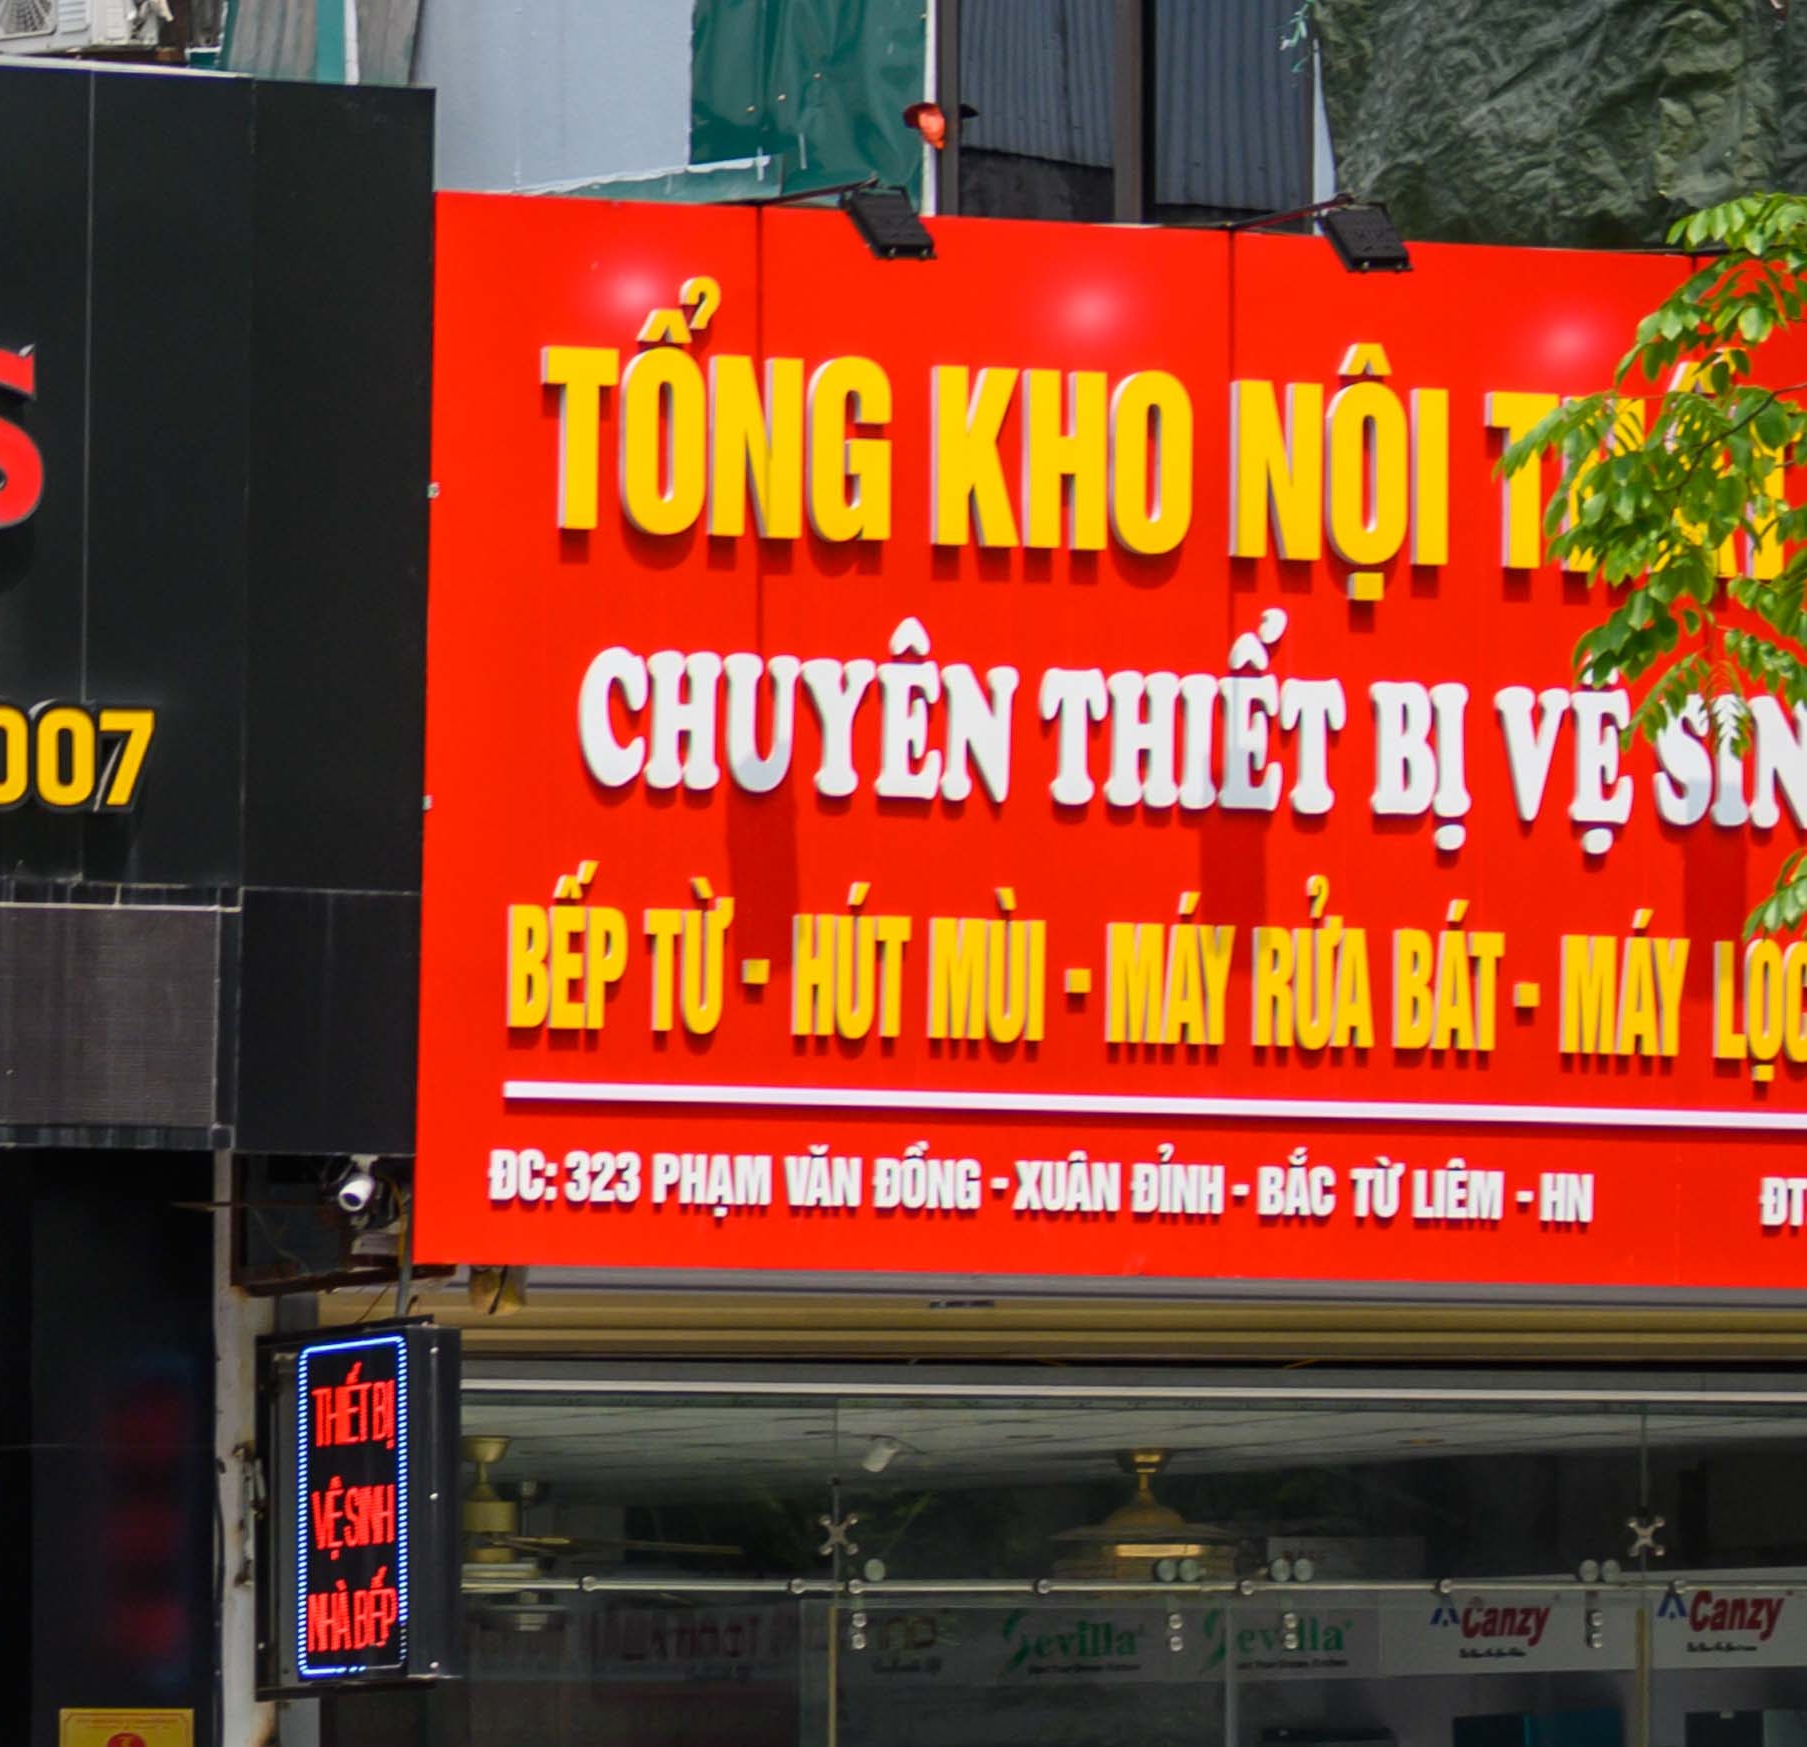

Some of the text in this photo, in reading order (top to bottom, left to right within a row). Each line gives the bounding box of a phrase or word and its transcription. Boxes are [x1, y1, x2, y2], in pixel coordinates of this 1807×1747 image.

[541, 276, 892, 543] TỔNG
[930, 364, 1193, 555] KHO
[1228, 343, 1450, 601] NỘI
[578, 616, 1020, 805] CHUYÊN
[1040, 607, 1346, 814] THIẾT
[1370, 681, 1471, 852] BỊ
[1494, 655, 1634, 855] VỆ
[506, 860, 627, 1031] BẾP
[643, 877, 735, 1035] TỪ
[791, 882, 912, 1040] HÚT
[926, 887, 1047, 1044] MÙI
[1105, 891, 1236, 1046] MÁY
[1251, 874, 1375, 1051] RỬA
[1391, 899, 1505, 1052] BÁT
[1559, 908, 1691, 1057] MÁY
[1713, 938, 1807, 1082] LỌC
[488, 1148, 558, 1202] ĐC:
[564, 1150, 641, 1204] 323
[652, 1153, 772, 1221] PHẠM
[784, 1144, 862, 1208] VĂN
[873, 1140, 981, 1211] ĐỒNG
[1013, 1150, 1121, 1213] XUÂN
[1130, 1143, 1224, 1215] ĐỈNH
[1258, 1147, 1336, 1217] BẮC
[1351, 1156, 1406, 1219] TỪ
[1413, 1158, 1504, 1221] LIÊM
[1540, 1172, 1594, 1224] HN
[372, 1378, 396, 1450] BỊ
[311, 1475, 396, 1561] VỆ SINH
[307, 1565, 398, 1652] NHÀ BẾP
[1202, 1608, 1347, 1676] Sevlla
[1460, 1605, 1550, 1647] Canzy
[1688, 1589, 1785, 1641] Canzy
